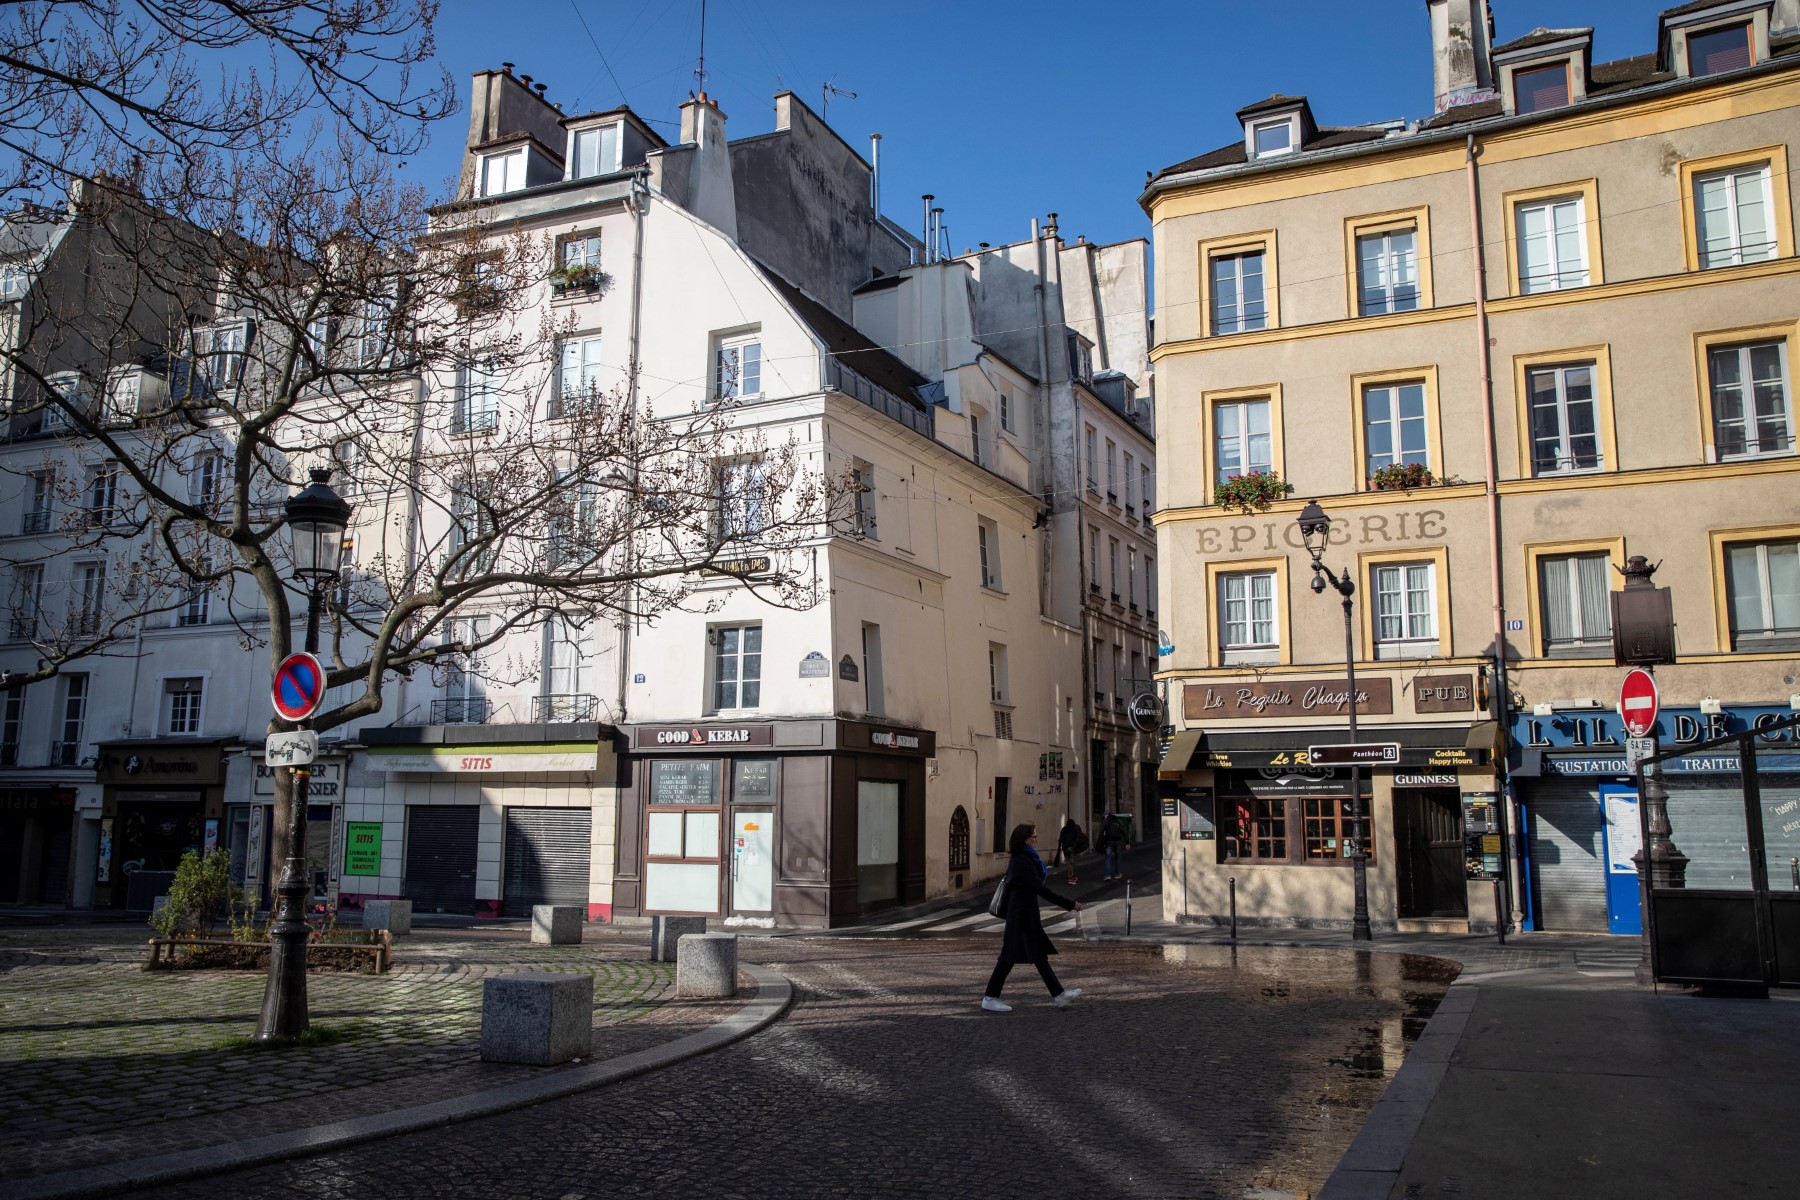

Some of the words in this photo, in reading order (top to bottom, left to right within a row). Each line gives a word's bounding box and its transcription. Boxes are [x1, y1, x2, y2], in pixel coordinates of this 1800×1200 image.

[1195, 509, 1448, 555] EPICERIE
[1508, 620, 1521, 630] 10
[1203, 688, 1223, 710] Le
[1236, 688, 1293, 713] Requin
[1302, 685, 1370, 711] Chagrin
[1418, 686, 1469, 703] PUB
[1135, 707, 1162, 716] GUINNESS
[1673, 712, 1729, 744] DE
[657, 730, 690, 743] GOOD
[707, 729, 749, 742] KEBAB
[1270, 752, 1290, 765] Le
[1352, 750, 1383, 758] Panthéon
[144, 756, 199, 776] Amorino
[460, 757, 493, 770] SITIS
[1428, 758, 1451, 766] Happy
[1681, 758, 1742, 770] TRAITEU
[1395, 774, 1456, 784] GUINNESS
[355, 834, 375, 844] SITIS
